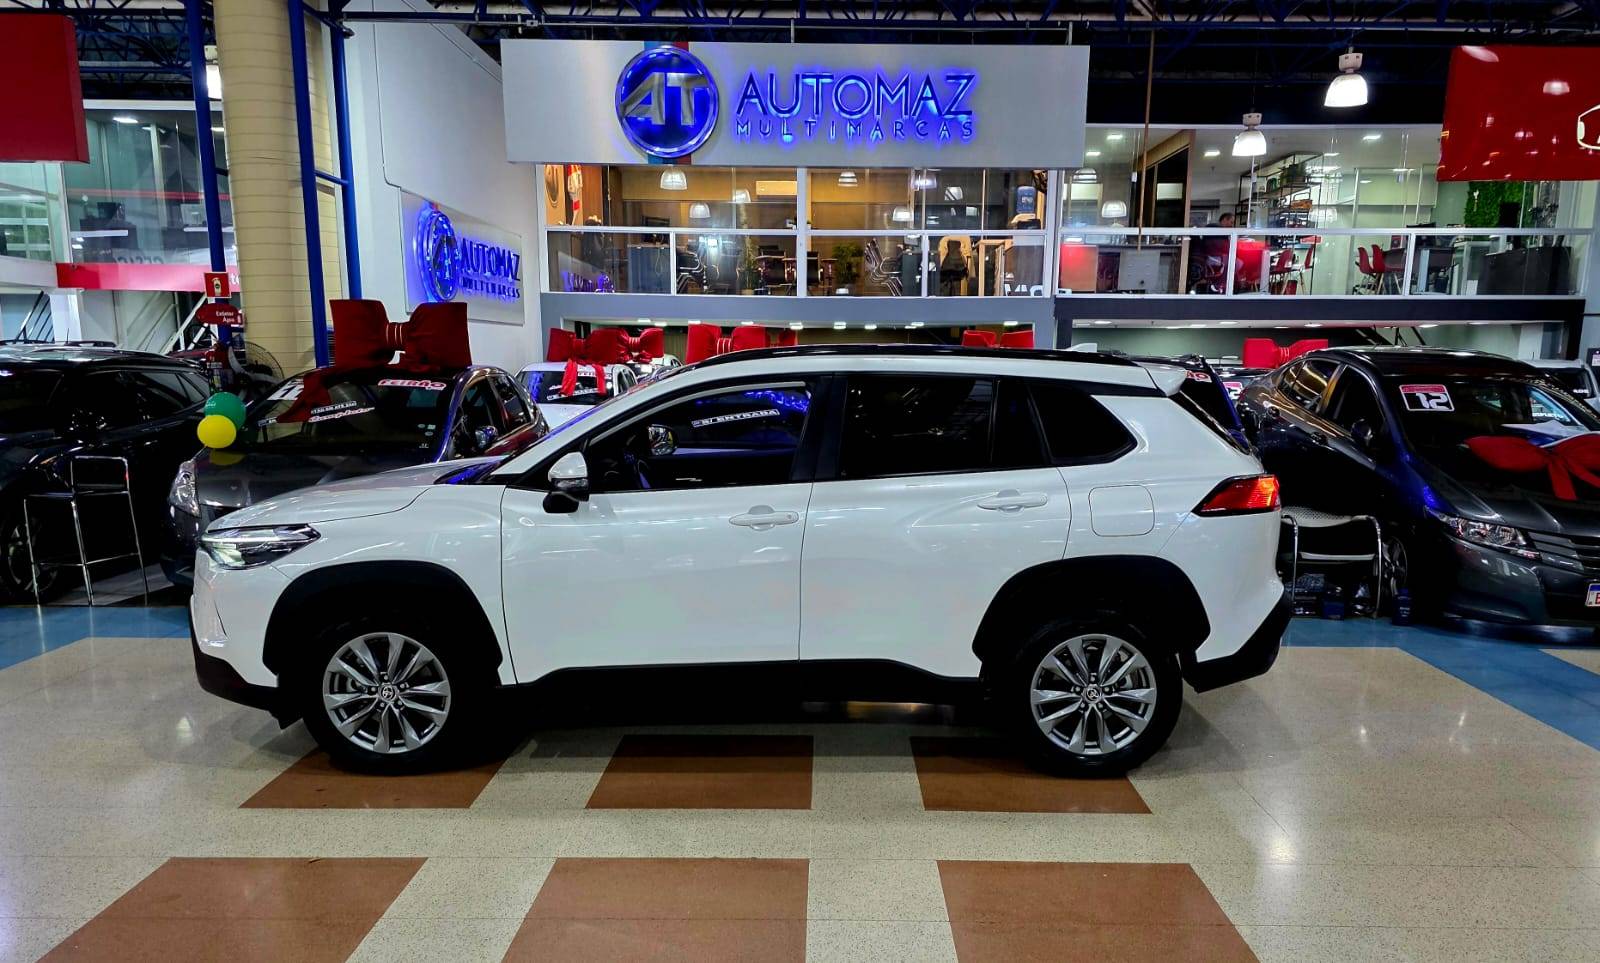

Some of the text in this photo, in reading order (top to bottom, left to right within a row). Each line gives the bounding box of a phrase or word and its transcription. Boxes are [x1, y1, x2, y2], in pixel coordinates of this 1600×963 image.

[735, 72, 976, 117] AUTOMAZ
[736, 119, 973, 137] MULTIMARCAS
[460, 238, 521, 282] AUTOMAZ
[461, 276, 521, 299] MULTIMARCAS
[1415, 392, 1450, 410] 12
